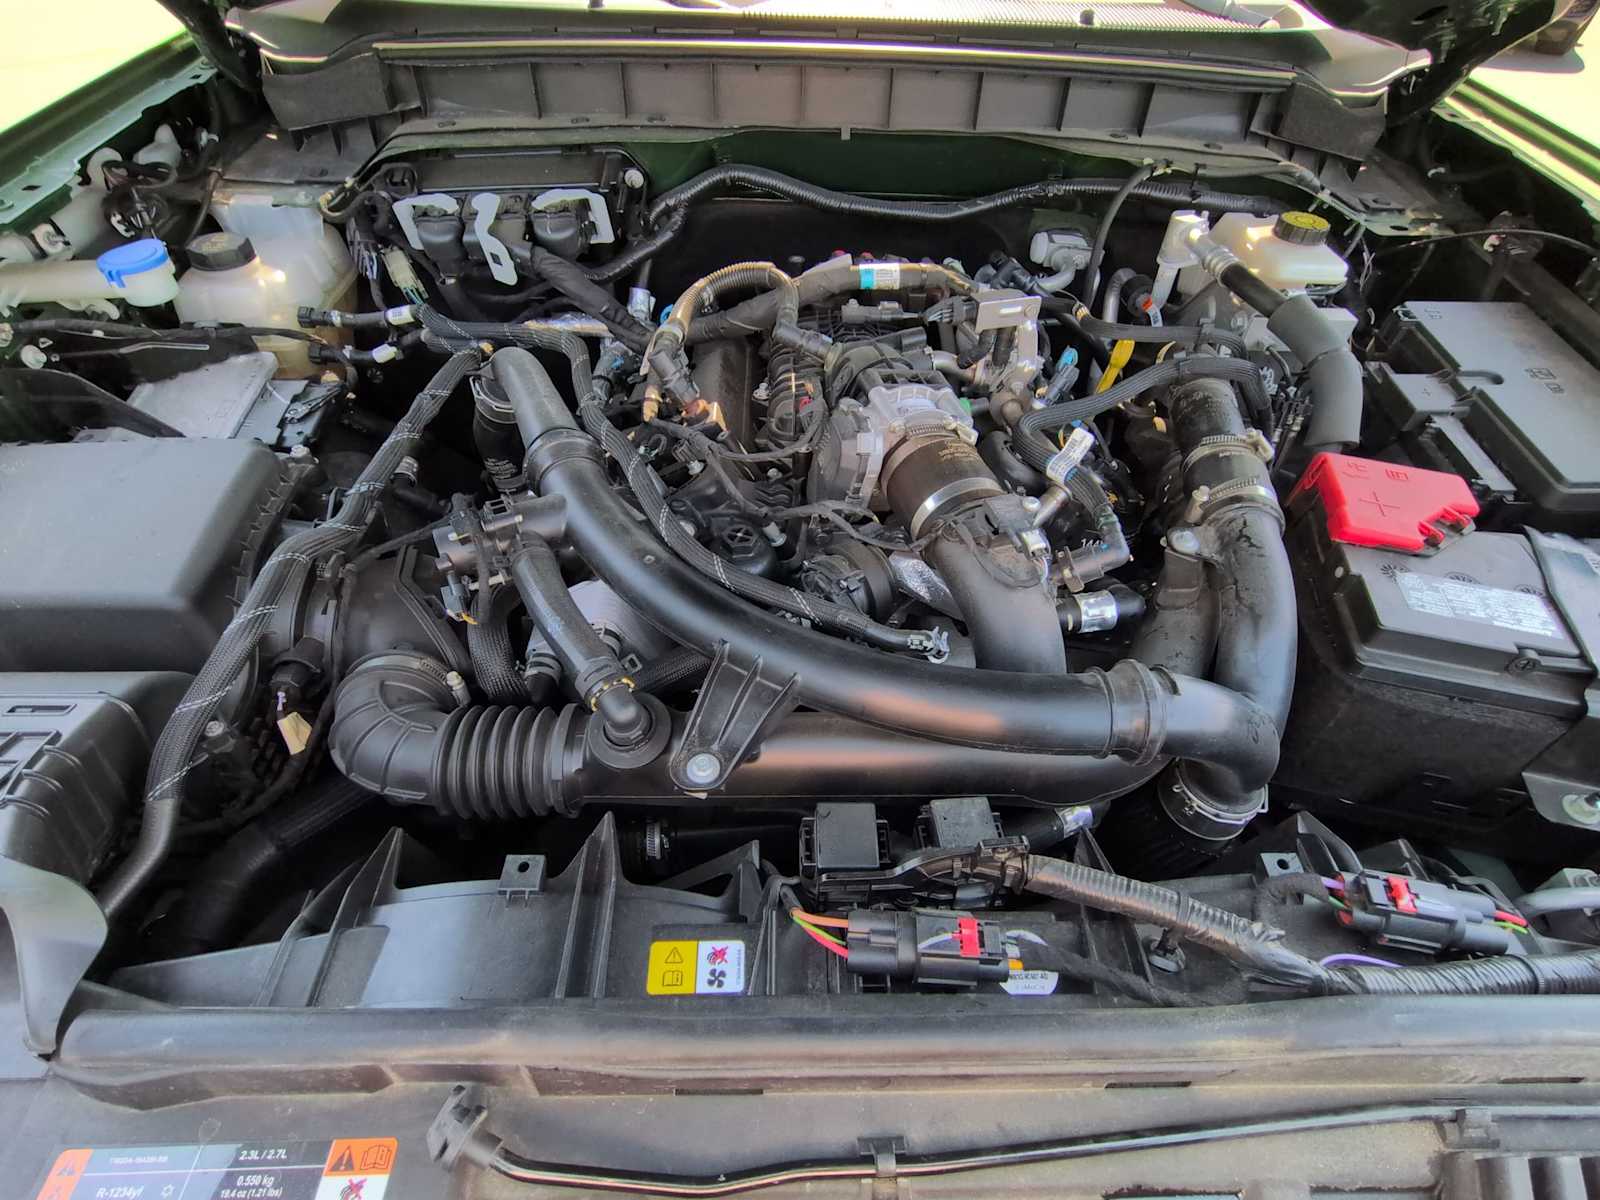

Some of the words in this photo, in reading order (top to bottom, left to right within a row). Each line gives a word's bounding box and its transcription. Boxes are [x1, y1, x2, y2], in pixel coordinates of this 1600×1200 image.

[239, 1150, 260, 1160] 2.3L
[267, 1148, 288, 1159] 2.7L
[237, 1175, 261, 1186] 0.550
[262, 1174, 274, 1187] kg
[96, 1185, 145, 1198] R-1234yf
[237, 1190, 247, 1199] oz
[266, 1186, 284, 1198] lbs)
